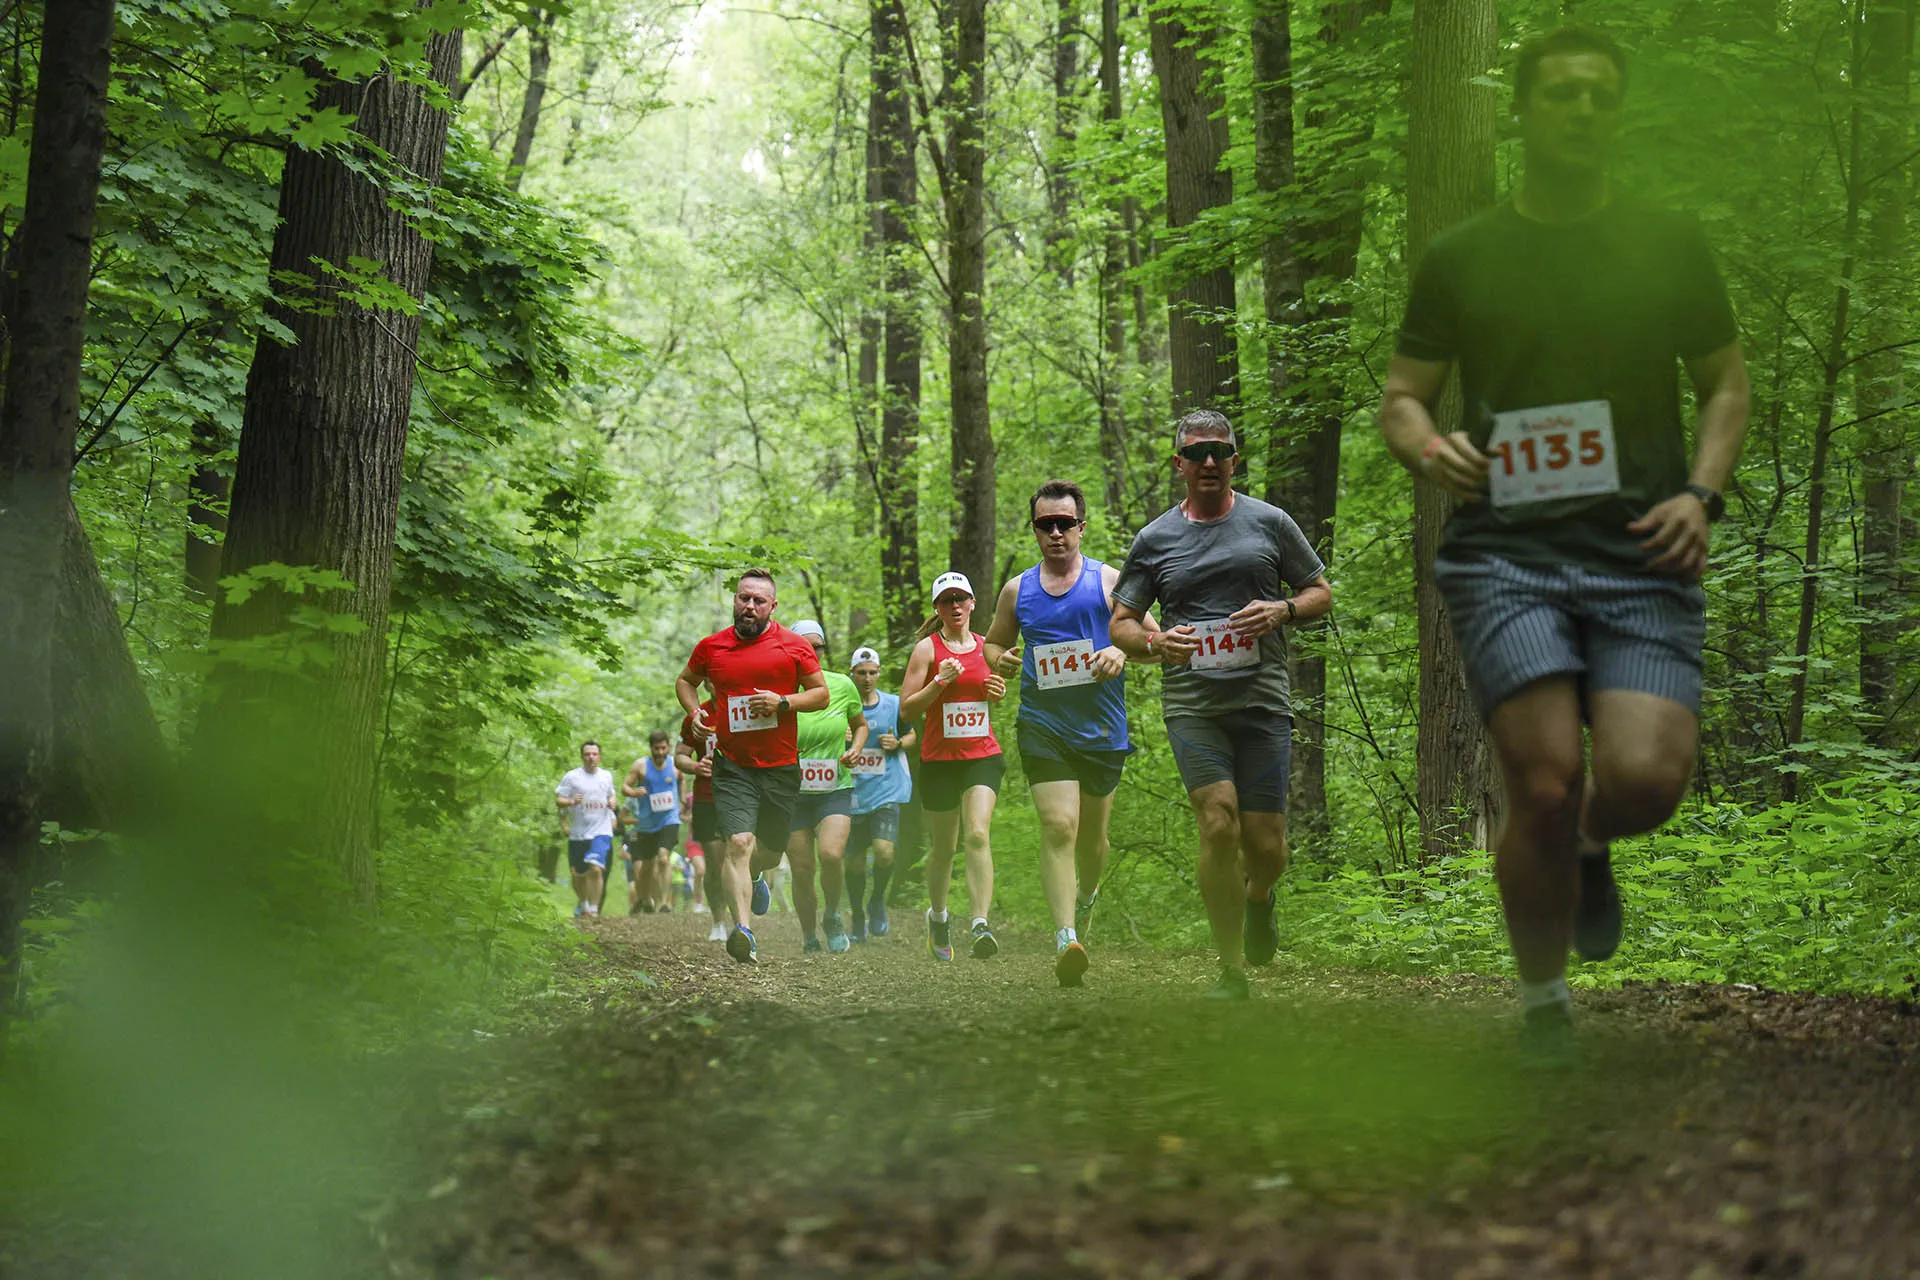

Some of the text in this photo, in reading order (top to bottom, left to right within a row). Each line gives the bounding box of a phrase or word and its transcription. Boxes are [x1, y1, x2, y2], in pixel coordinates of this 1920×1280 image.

[1498, 430, 1605, 476] 1135
[1197, 633, 1253, 657] 1144
[947, 712, 985, 727] 1037
[857, 756, 883, 767] 067
[800, 768, 835, 781] 1010
